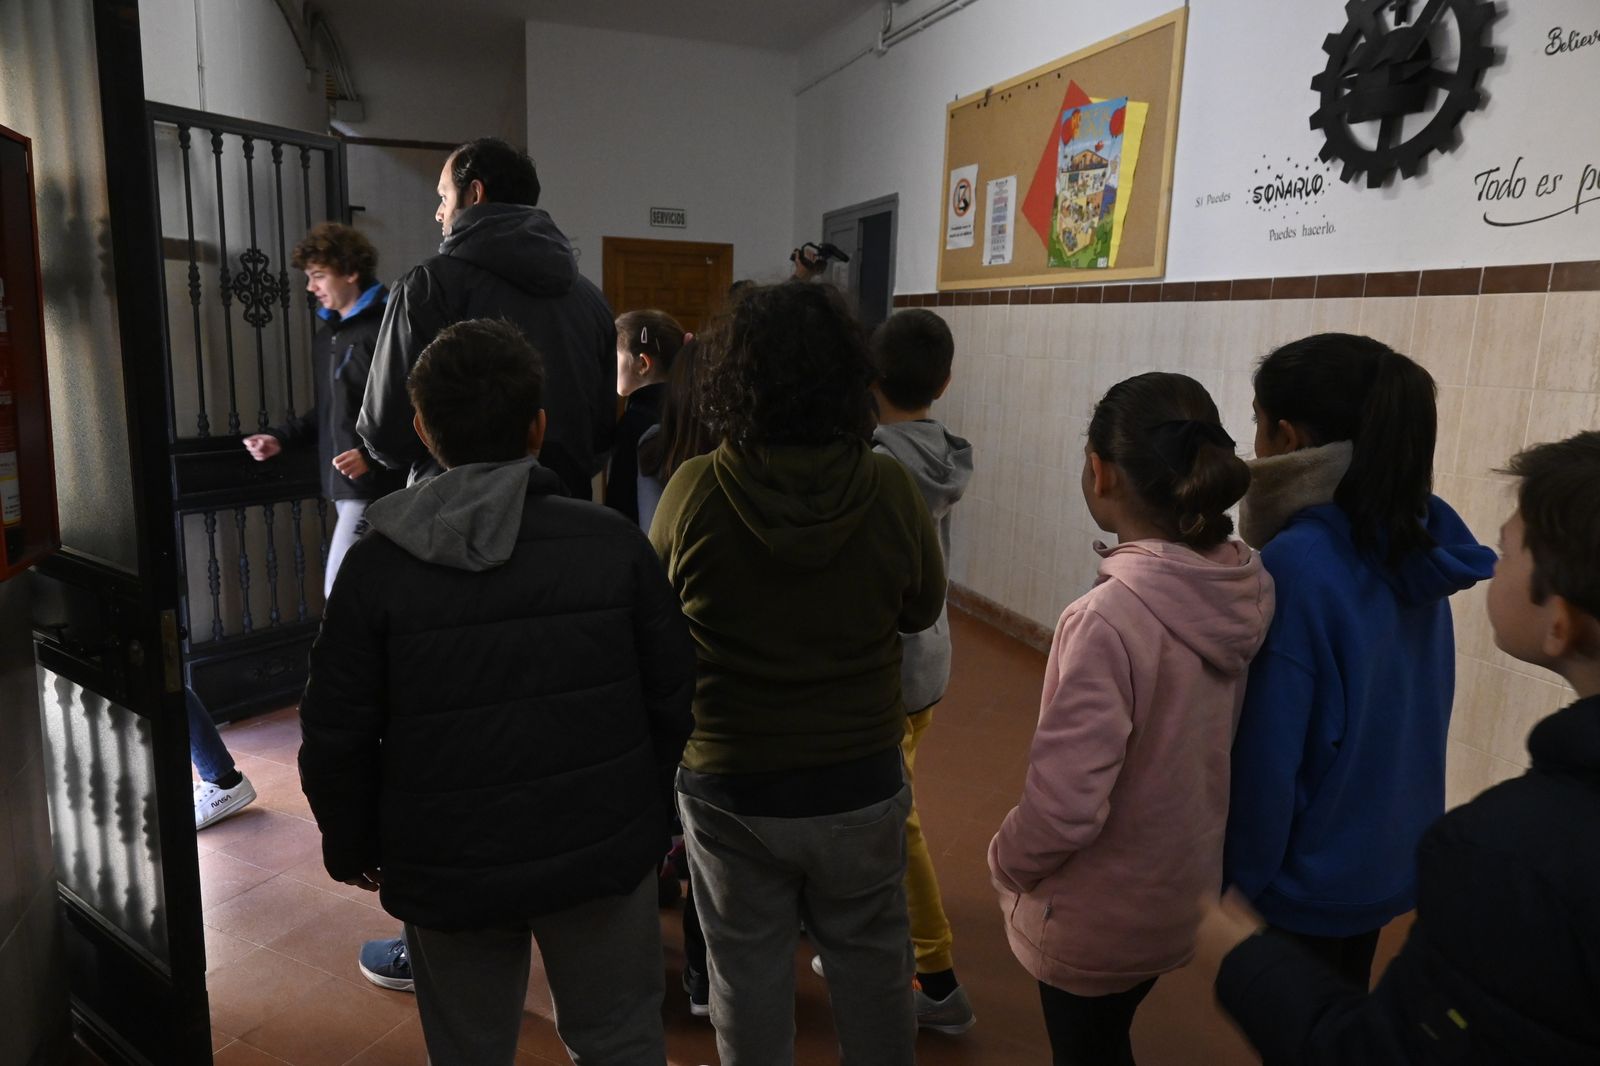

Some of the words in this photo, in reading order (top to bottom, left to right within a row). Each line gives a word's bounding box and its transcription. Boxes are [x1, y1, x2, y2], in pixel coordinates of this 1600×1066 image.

[1545, 26, 1600, 56] Believ
[1474, 156, 1527, 201] Todo
[1535, 174, 1564, 198] es
[1574, 163, 1600, 215] p
[1206, 191, 1232, 206] Puedes
[653, 211, 685, 225] SERVICIOS
[1269, 226, 1297, 242] Puedes
[210, 795, 232, 808] NASA
